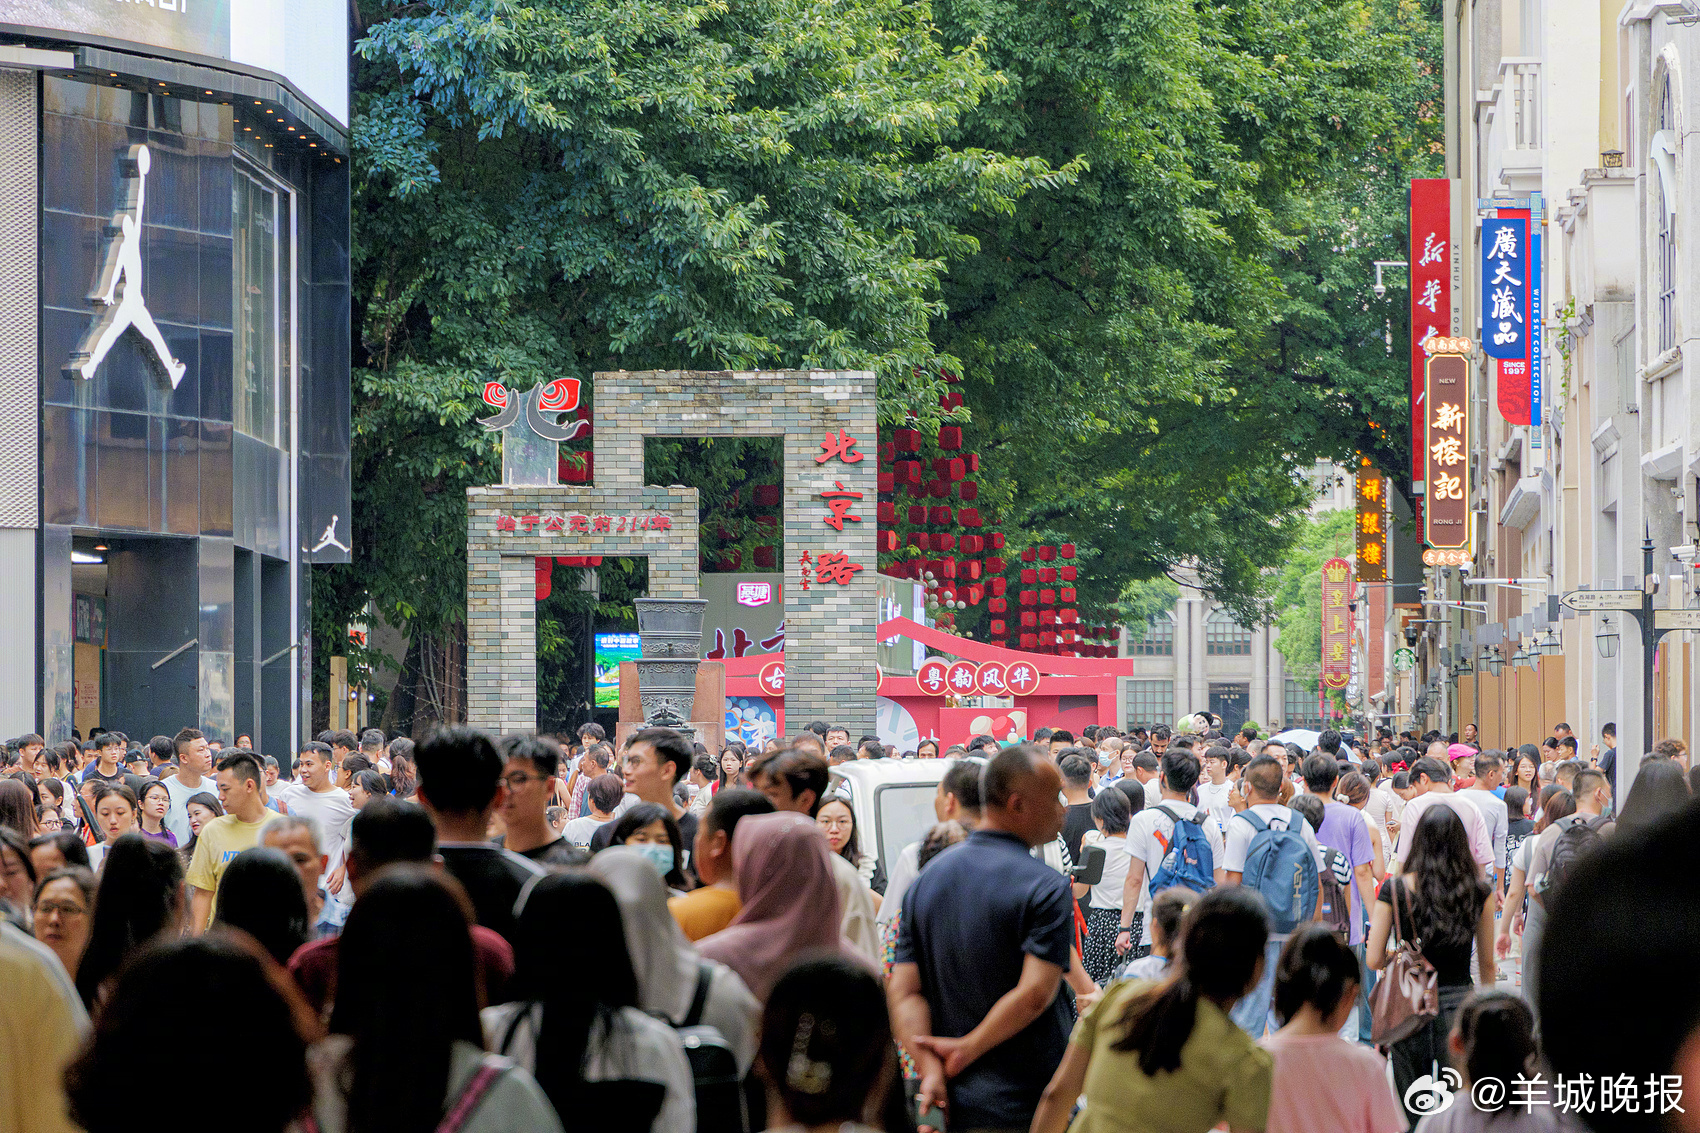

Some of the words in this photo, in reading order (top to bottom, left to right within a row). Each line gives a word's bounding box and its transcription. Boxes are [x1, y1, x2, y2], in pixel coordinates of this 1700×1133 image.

[1532, 288, 1540, 314] WIDE
[1532, 318, 1540, 337] SKY
[1532, 341, 1540, 404] COLLECTION
[1430, 402, 1466, 500] 新榕記
[496, 515, 672, 532] 始于公元前214年
[815, 428, 864, 585] 北京路
[1329, 588, 1345, 661] 皇上皇
[923, 666, 1032, 690] 粤韵风华
